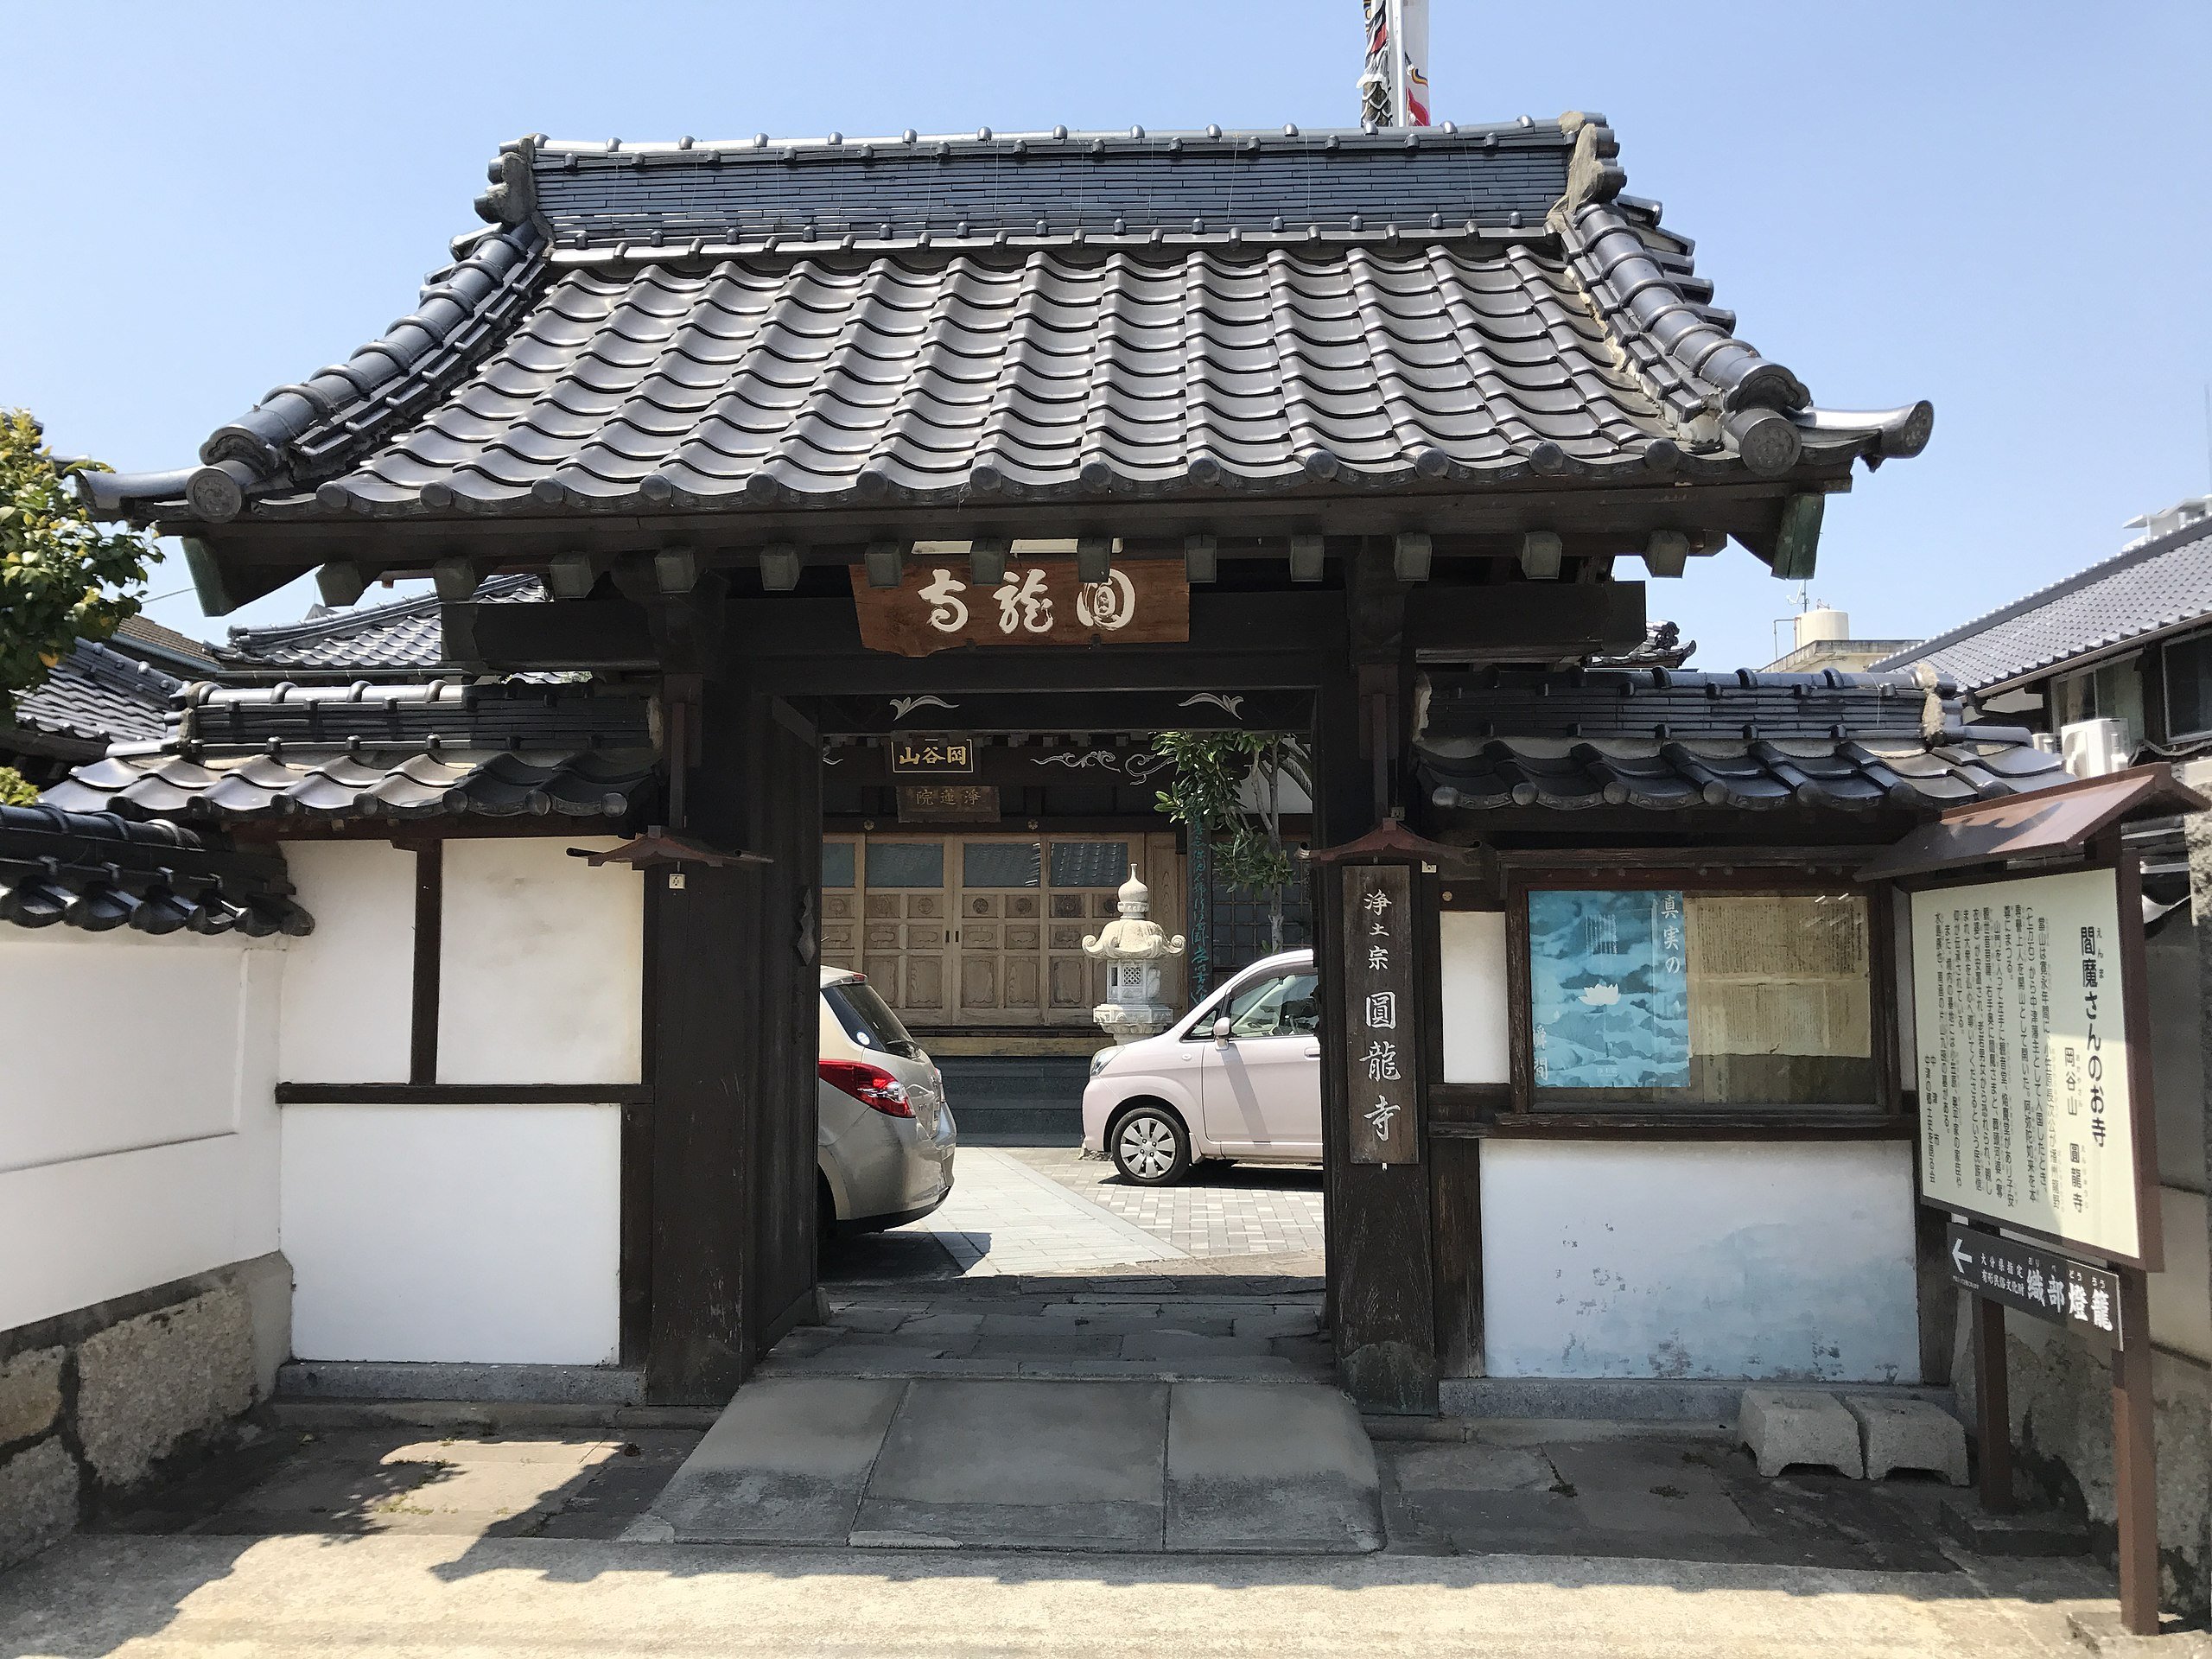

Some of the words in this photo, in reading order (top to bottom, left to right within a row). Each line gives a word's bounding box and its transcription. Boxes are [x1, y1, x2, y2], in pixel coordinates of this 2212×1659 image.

[1661, 894, 1681, 975] 真実の
[1359, 991, 1402, 1141] 圓龍寺
[2079, 925, 2107, 1148] 閻魔さんのお寺
[2063, 1047, 2077, 1116] 岡谷山
[2069, 1142, 2083, 1214] 圓龍寺
[1981, 1253, 2024, 1279] 大分県指定
